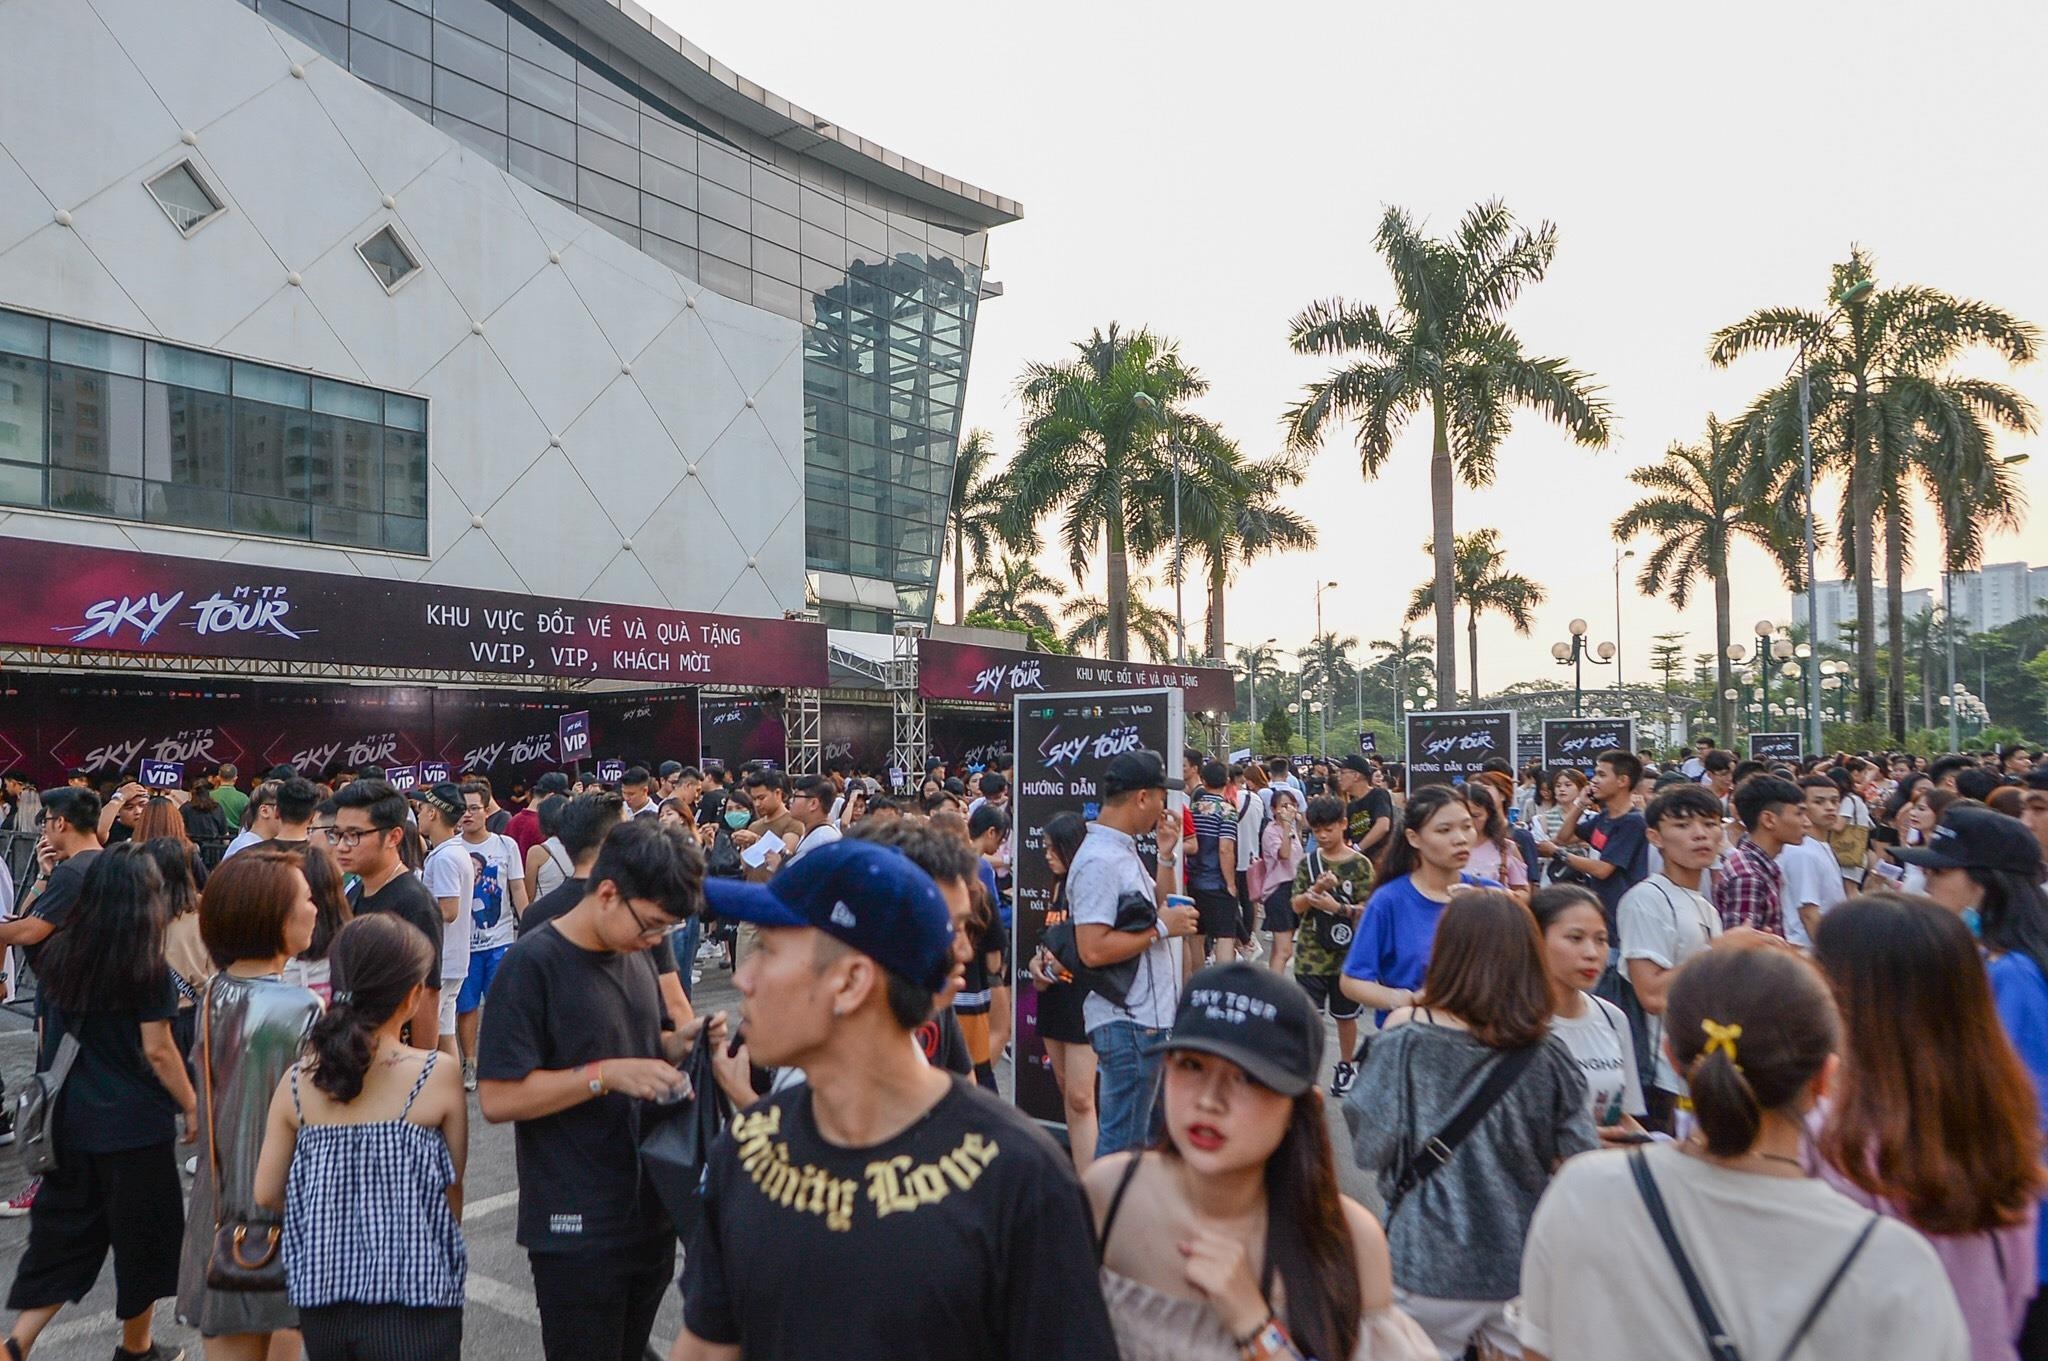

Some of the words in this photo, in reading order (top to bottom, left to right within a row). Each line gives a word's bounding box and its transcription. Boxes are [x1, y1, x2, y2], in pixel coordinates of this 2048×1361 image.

[232, 586, 288, 598] M-TP
[69, 590, 184, 646] SKY
[189, 590, 301, 640] TOUR
[426, 604, 471, 627] KHU
[483, 608, 525, 636] VỰC
[537, 607, 575, 635] ĐỔI
[587, 614, 612, 638] VÉ
[622, 617, 647, 640] VÀ
[657, 621, 691, 645] QUÀ
[700, 622, 741, 649] TẶNG
[470, 641, 536, 669] VVIP,
[550, 646, 598, 672] VIP,
[613, 647, 670, 671] KHÁCH
[679, 650, 711, 672] MỜI
[973, 665, 1007, 695] SKY
[1008, 665, 1045, 691] TOUR
[1076, 667, 1093, 681] KHU
[1096, 669, 1113, 685] VỰC
[1149, 671, 1160, 686] VÀ
[563, 732, 588, 752] VIP
[1044, 735, 1090, 767] SKY
[1091, 734, 1139, 759] TOUR
[1362, 742, 1374, 750] GA
[1426, 736, 1458, 755] SKY
[1459, 735, 1495, 750] TOUR
[84, 737, 147, 774] SKY
[150, 737, 221, 765] TOUR
[291, 741, 342, 772] SKY
[344, 740, 402, 767] TOUR
[460, 741, 505, 773] SKY
[508, 740, 557, 765] TOUR
[146, 769, 178, 785] VIP
[391, 775, 415, 790] VIP
[424, 770, 447, 783] VIP
[601, 769, 623, 781] VIP
[1022, 779, 1064, 796] HƯỚNG
[1071, 777, 1097, 796] DẪN
[1225, 991, 1277, 1021] TOUR
[864, 1133, 1000, 1219] Love
